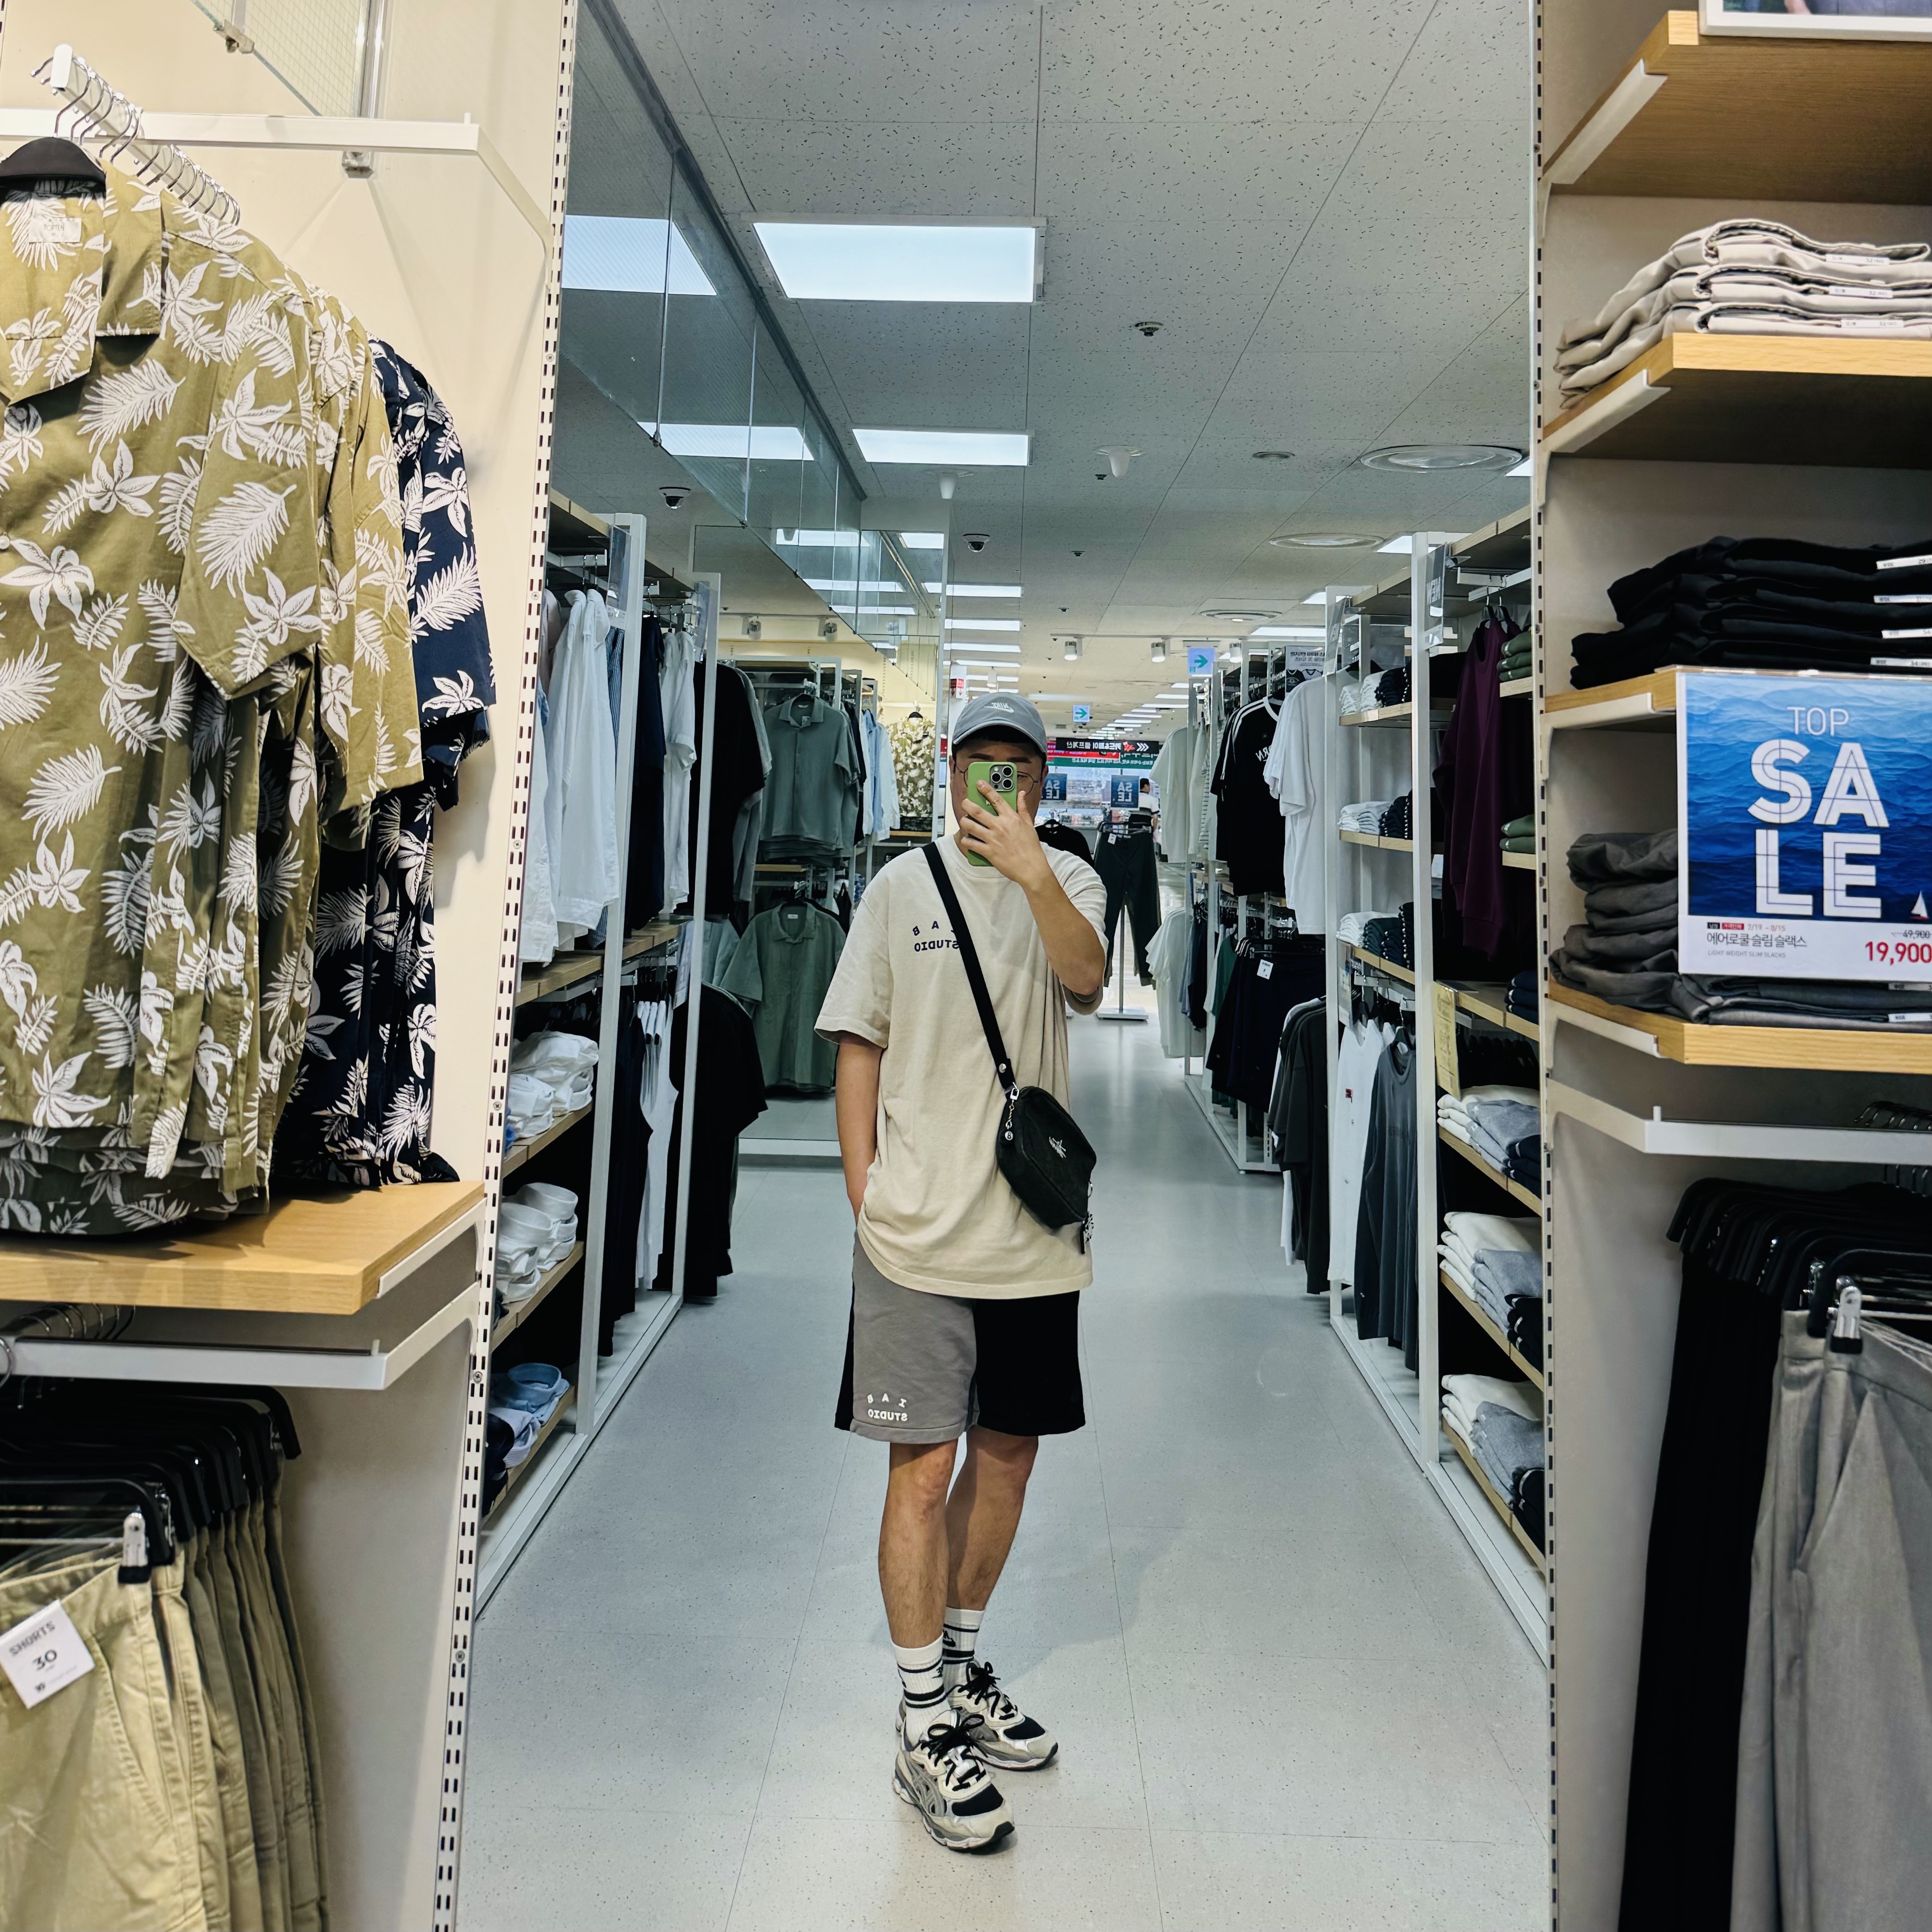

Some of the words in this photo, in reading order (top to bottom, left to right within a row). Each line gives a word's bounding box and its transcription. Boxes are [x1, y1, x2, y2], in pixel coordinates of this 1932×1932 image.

[1787, 707, 1849, 736] TOP
[1707, 932, 1750, 946] 에어로쿨
[1751, 934, 1773, 947] 슬림
[1774, 934, 1807, 948] 슬랙스
[1865, 941, 1932, 966] 19,900
[9, 1621, 55, 1656] SHORTS
[33, 1650, 57, 1671] 30
